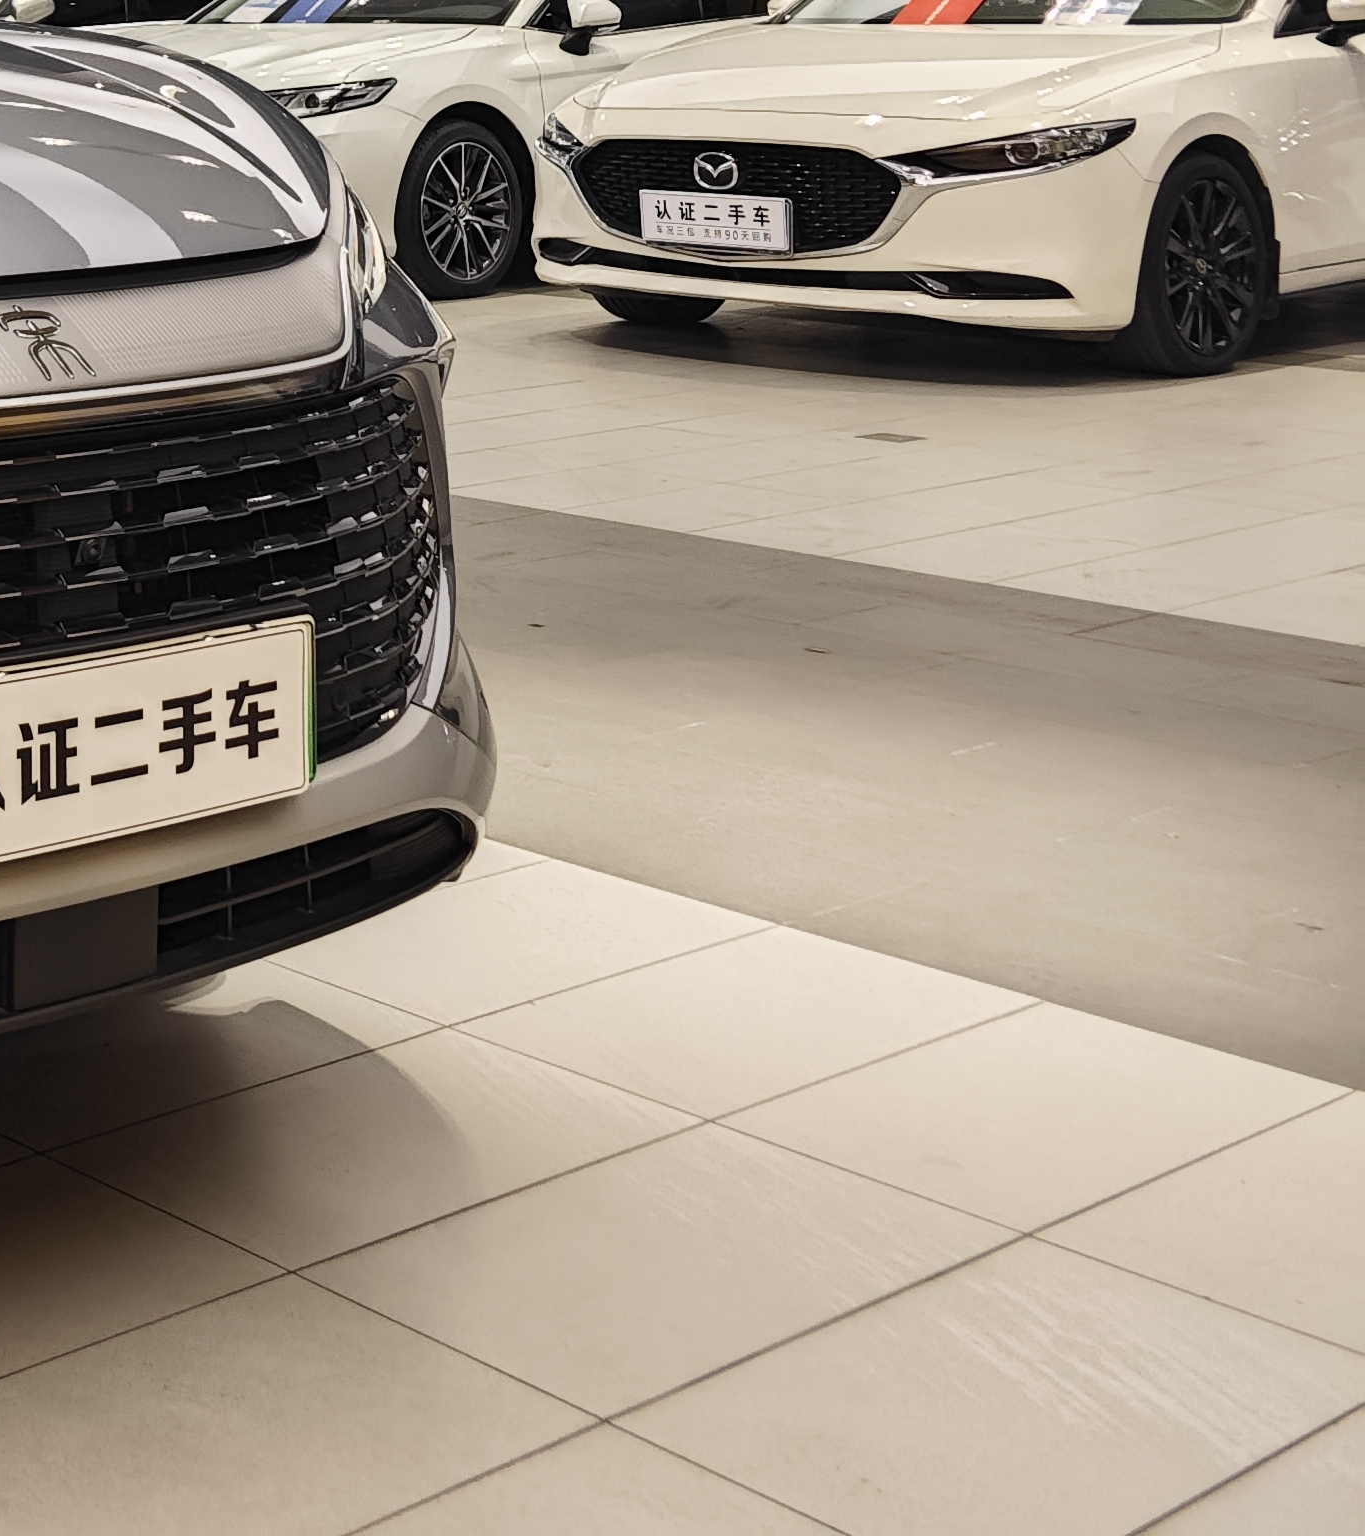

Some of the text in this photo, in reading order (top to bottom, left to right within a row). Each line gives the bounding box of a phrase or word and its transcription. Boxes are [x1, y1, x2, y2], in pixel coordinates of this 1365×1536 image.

[655, 199, 771, 227] 认证二手车
